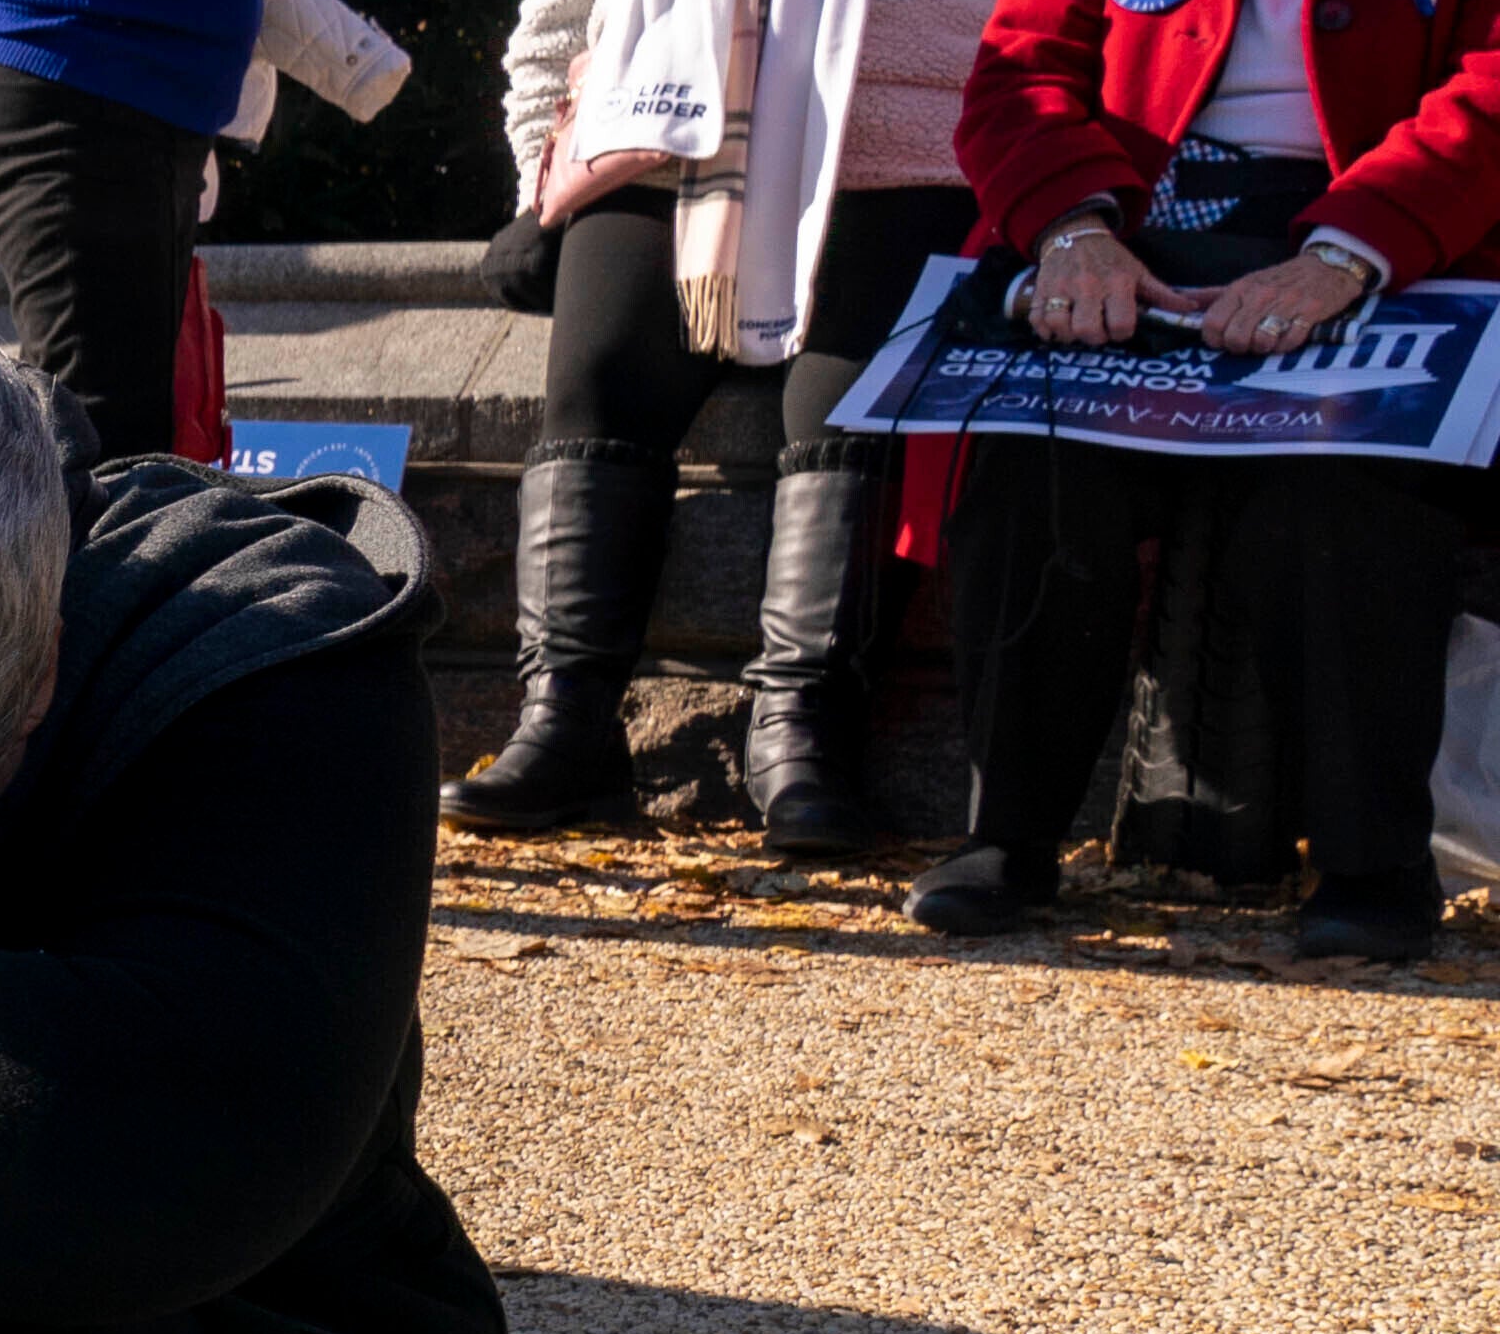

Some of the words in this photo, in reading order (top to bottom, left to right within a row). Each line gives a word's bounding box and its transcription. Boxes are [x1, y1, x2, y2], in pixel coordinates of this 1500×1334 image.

[638, 82, 693, 98] LIFE
[632, 99, 708, 119] RIDER
[1049, 350, 1215, 379] WOMEN
[940, 363, 1206, 393] CONCERNED
[1169, 410, 1324, 430] WOMEN
